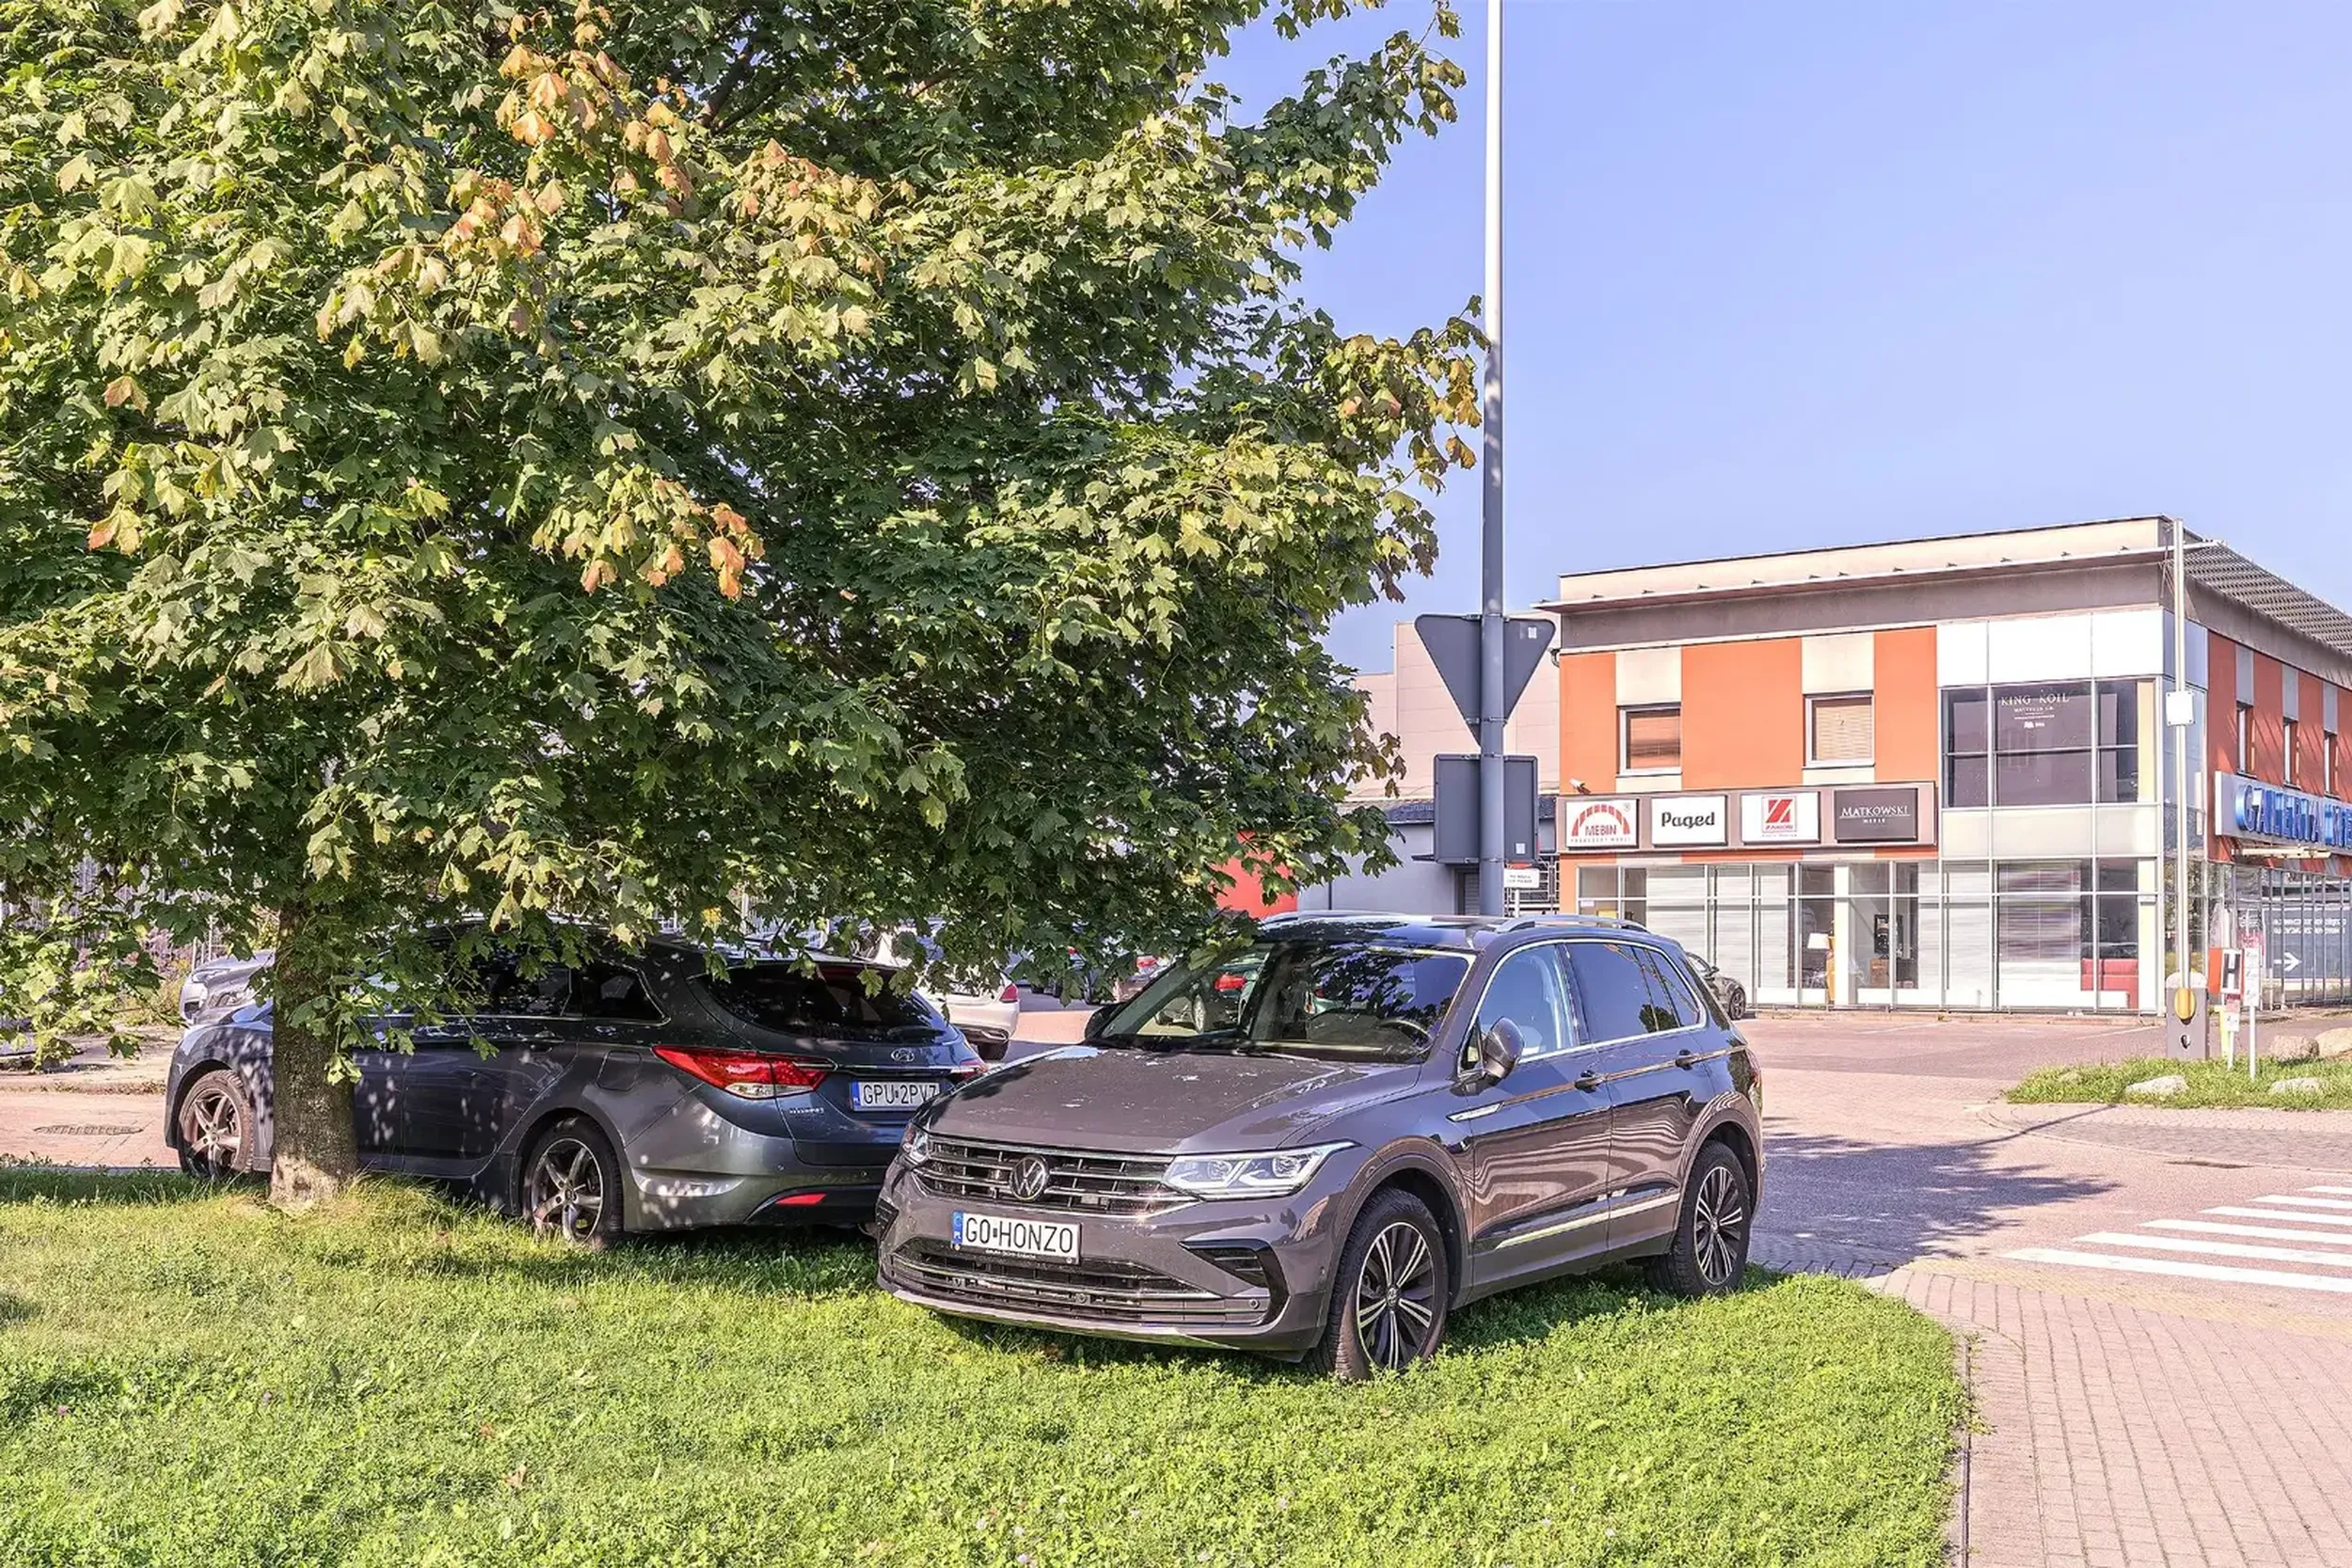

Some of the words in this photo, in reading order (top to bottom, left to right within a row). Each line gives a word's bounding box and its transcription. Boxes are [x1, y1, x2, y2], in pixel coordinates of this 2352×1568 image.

[2001, 695, 2031, 706] KING
[2040, 692, 2069, 704] KOIL
[1841, 805, 1909, 817] MATKOWSKI
[1661, 812, 1715, 829] Paged
[1585, 824, 1617, 836] MEBIN
[863, 1084, 895, 1104] GPU
